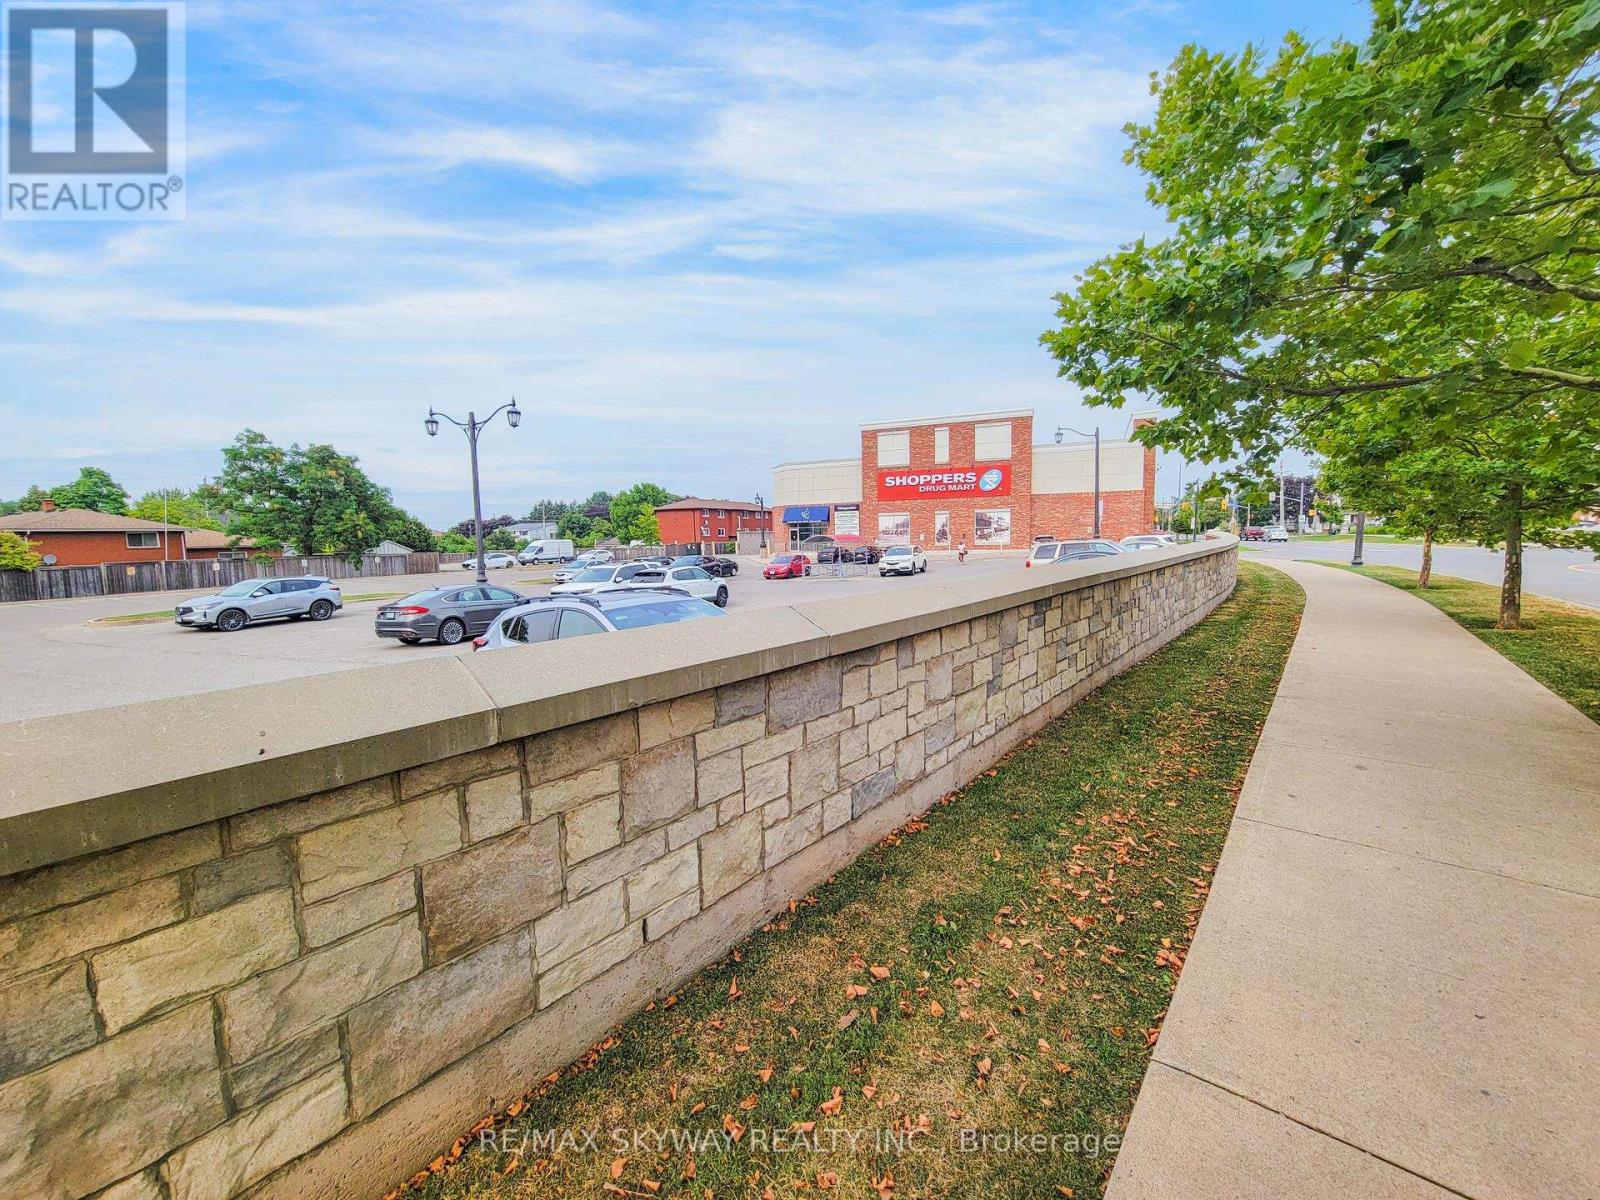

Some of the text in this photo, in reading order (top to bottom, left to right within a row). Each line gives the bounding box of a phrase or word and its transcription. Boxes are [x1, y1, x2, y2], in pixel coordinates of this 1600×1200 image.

[885, 472, 977, 487] SHOPPERS
[919, 483, 977, 493] DRUG MART
